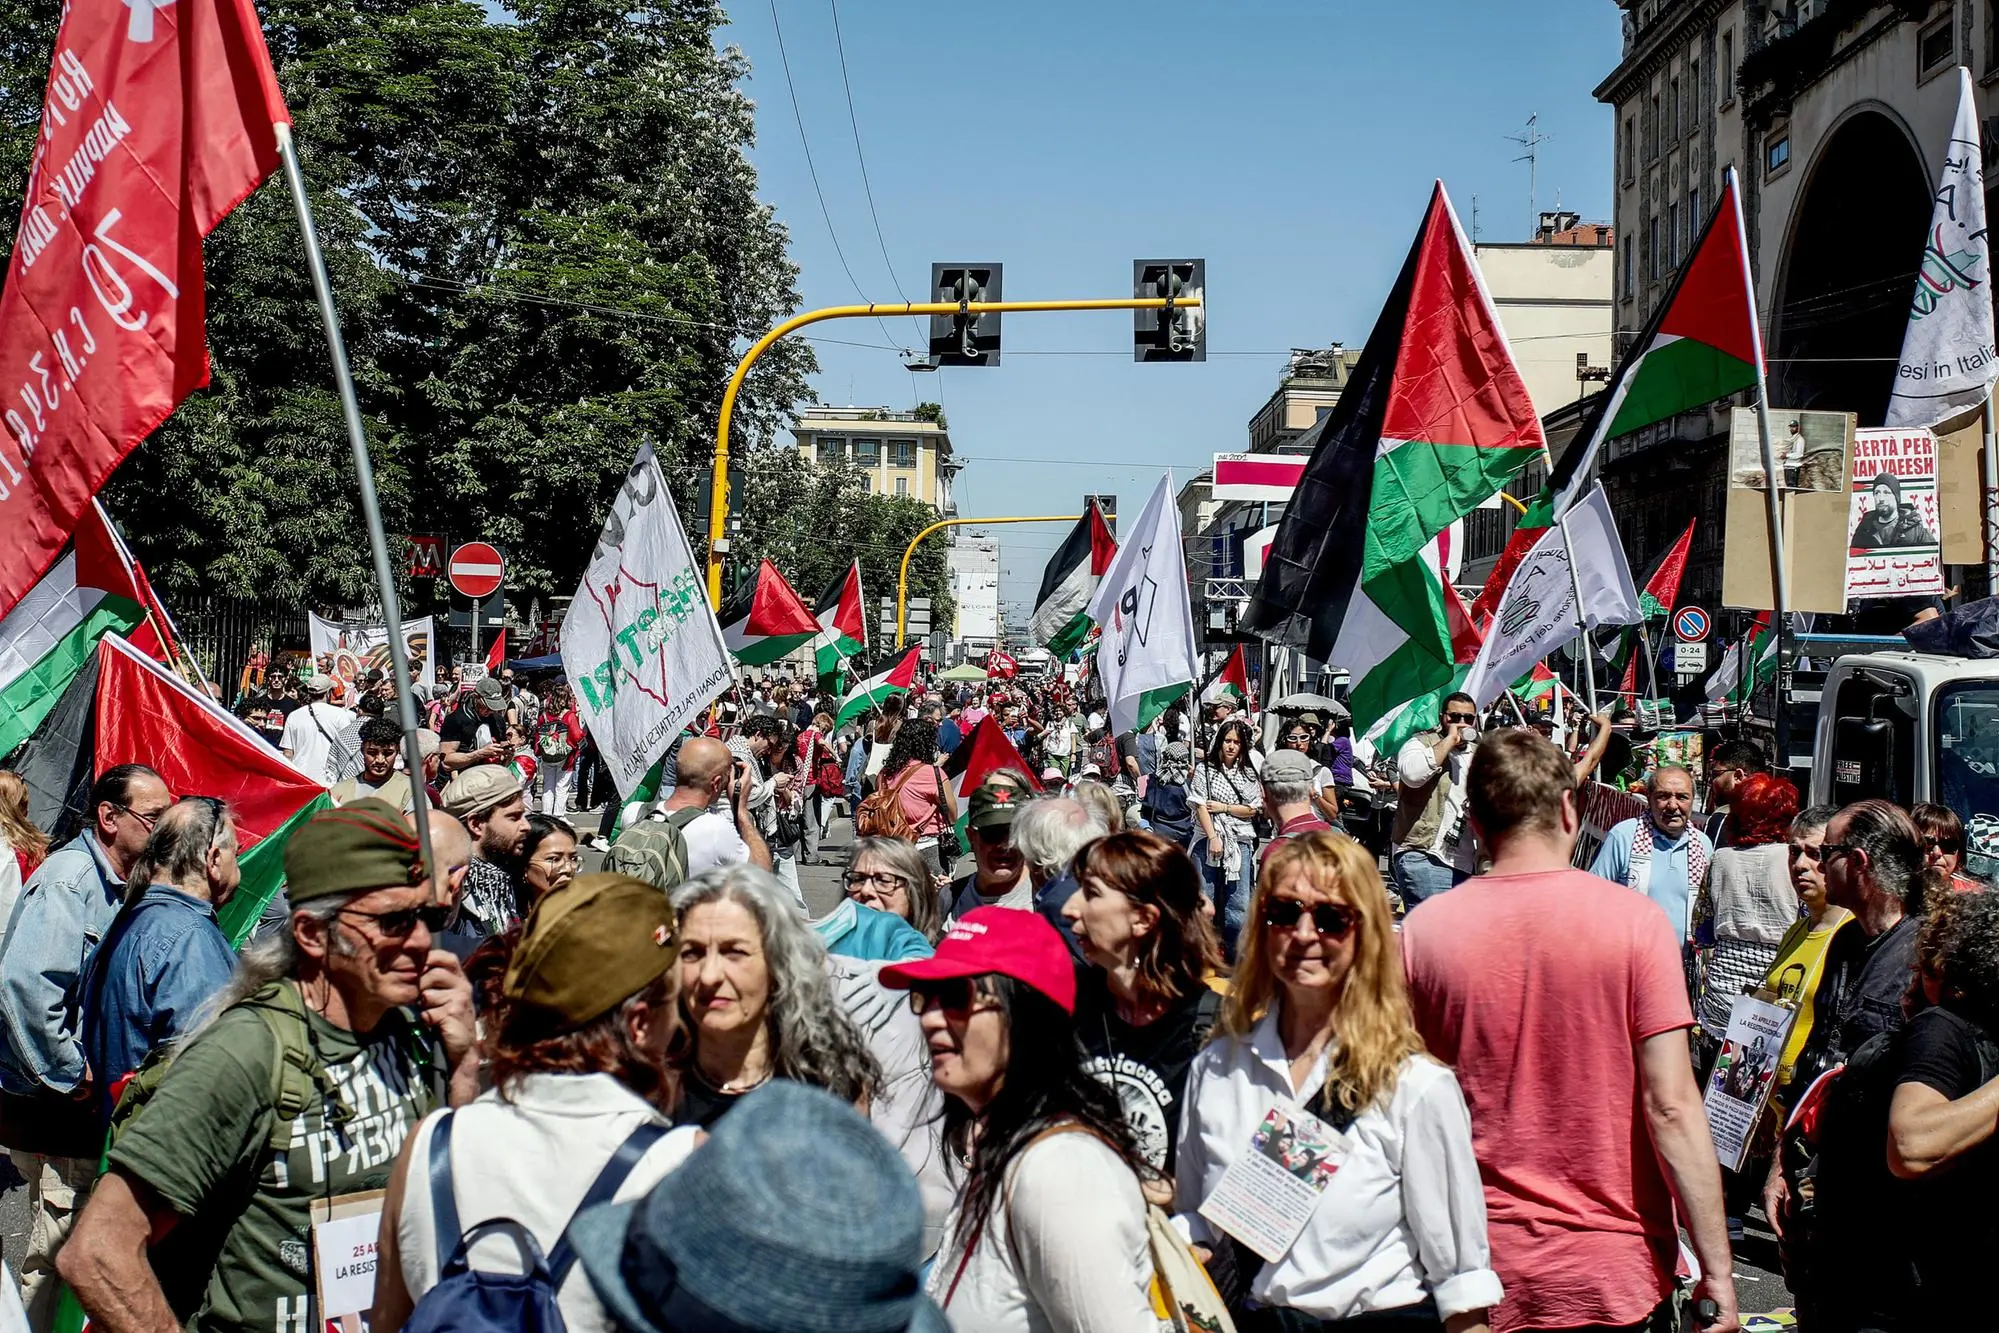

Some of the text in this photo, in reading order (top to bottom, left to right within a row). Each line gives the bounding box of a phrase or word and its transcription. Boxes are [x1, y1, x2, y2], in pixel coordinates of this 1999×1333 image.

[1933, 360, 1952, 379] in
[1903, 438, 1932, 455] PER
[1880, 457, 1934, 476] YAEESH
[411, 543, 442, 569] M
[353, 1245, 365, 1258] 25
[336, 1266, 349, 1280] LA
